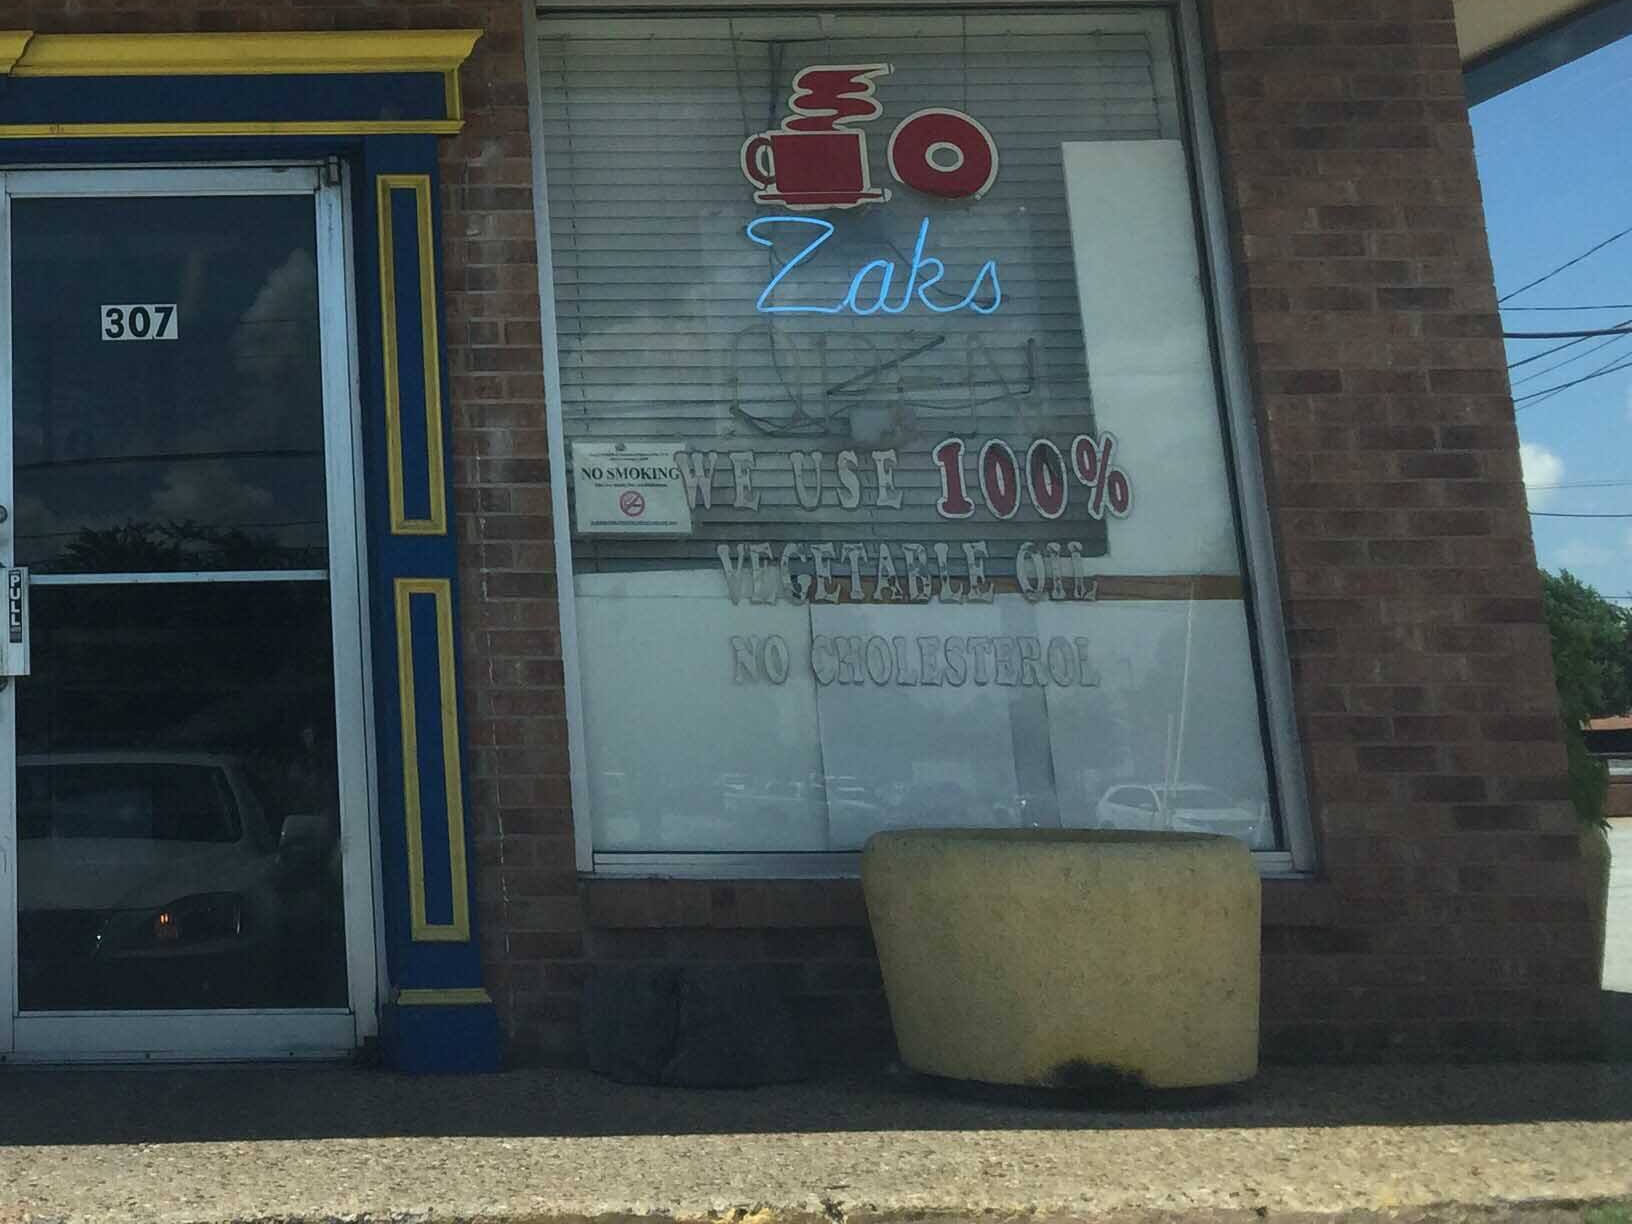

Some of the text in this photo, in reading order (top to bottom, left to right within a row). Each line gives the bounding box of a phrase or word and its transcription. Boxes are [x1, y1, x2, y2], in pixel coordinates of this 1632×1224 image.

[747, 216, 1002, 315] Zaks
[104, 306, 175, 339] 307
[581, 467, 680, 480] NO SMOKING
[674, 432, 1133, 520] WE USE 100%
[10, 575, 21, 626] PULL
[717, 541, 1097, 606] VEGETABLE OIL
[729, 634, 1102, 688] NO CHOLESTEROL
